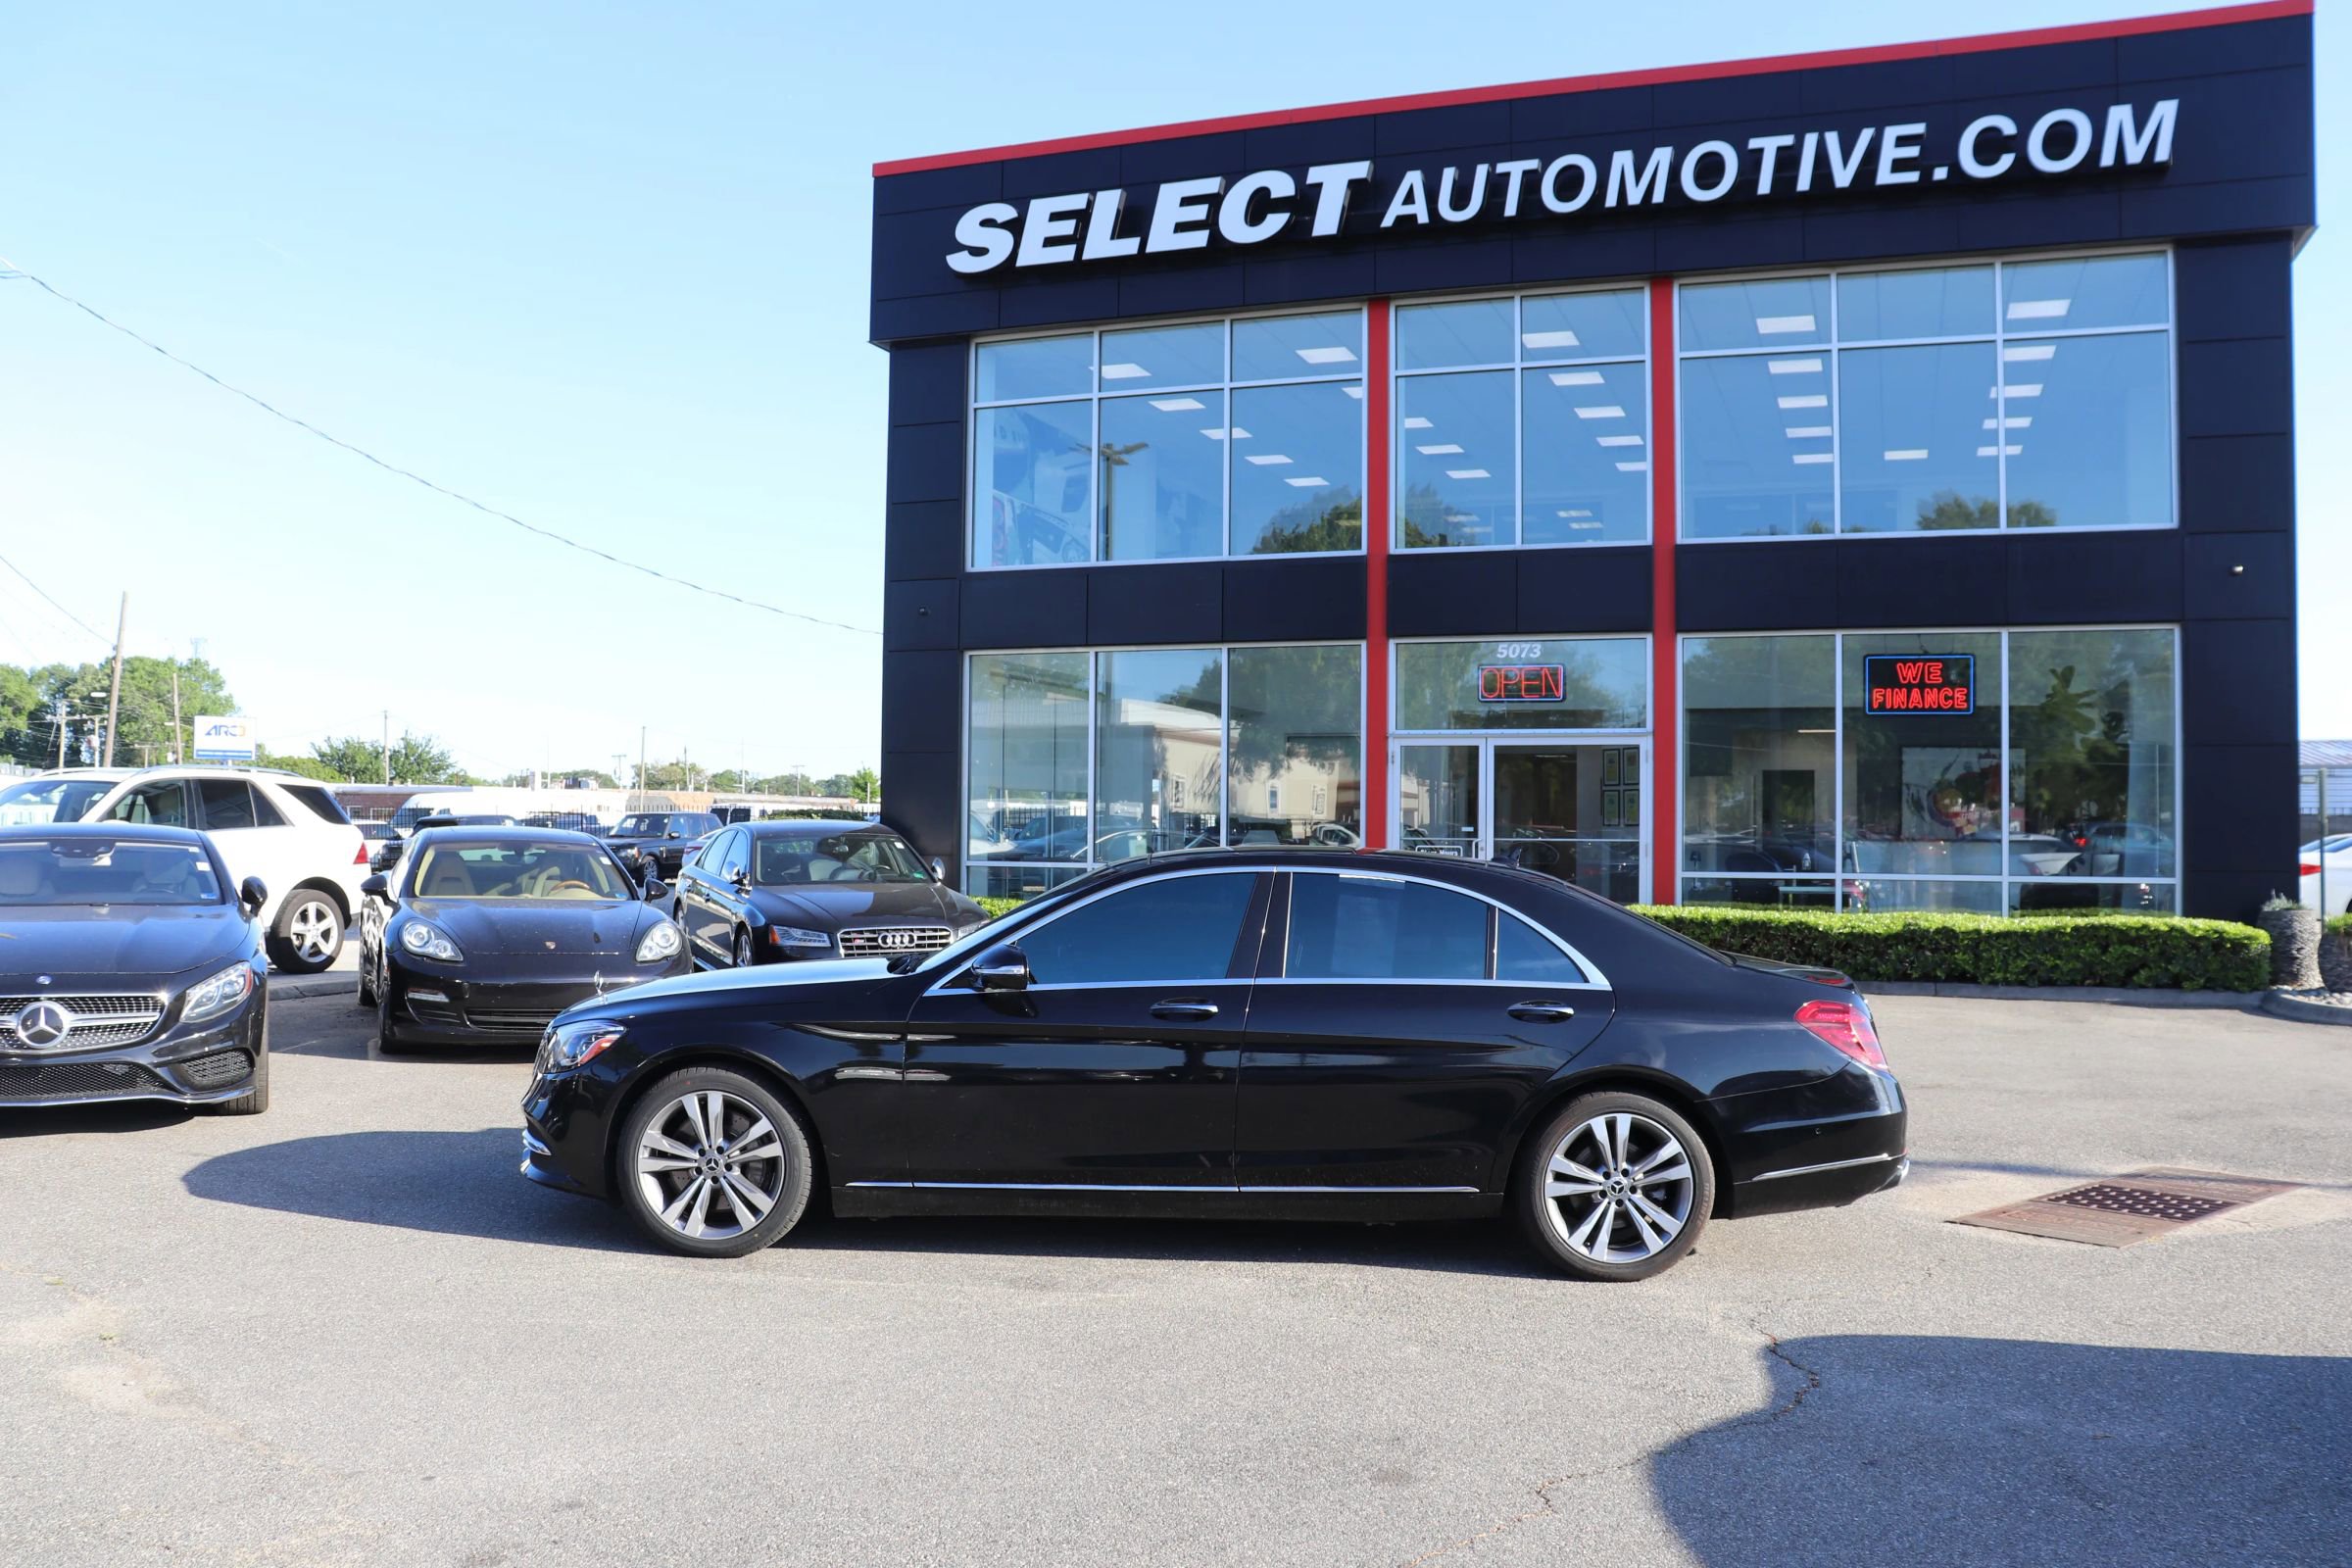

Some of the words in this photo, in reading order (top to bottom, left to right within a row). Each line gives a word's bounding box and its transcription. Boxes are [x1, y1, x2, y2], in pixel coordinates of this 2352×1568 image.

[946, 160, 1372, 274] SELECT
[1380, 99, 2180, 228] AUTOMOTIVE.COM
[1496, 643, 1543, 659] 5073
[1481, 666, 1562, 699] OPEN
[1896, 662, 1943, 684] WE
[1872, 687, 1968, 710] FINANCE
